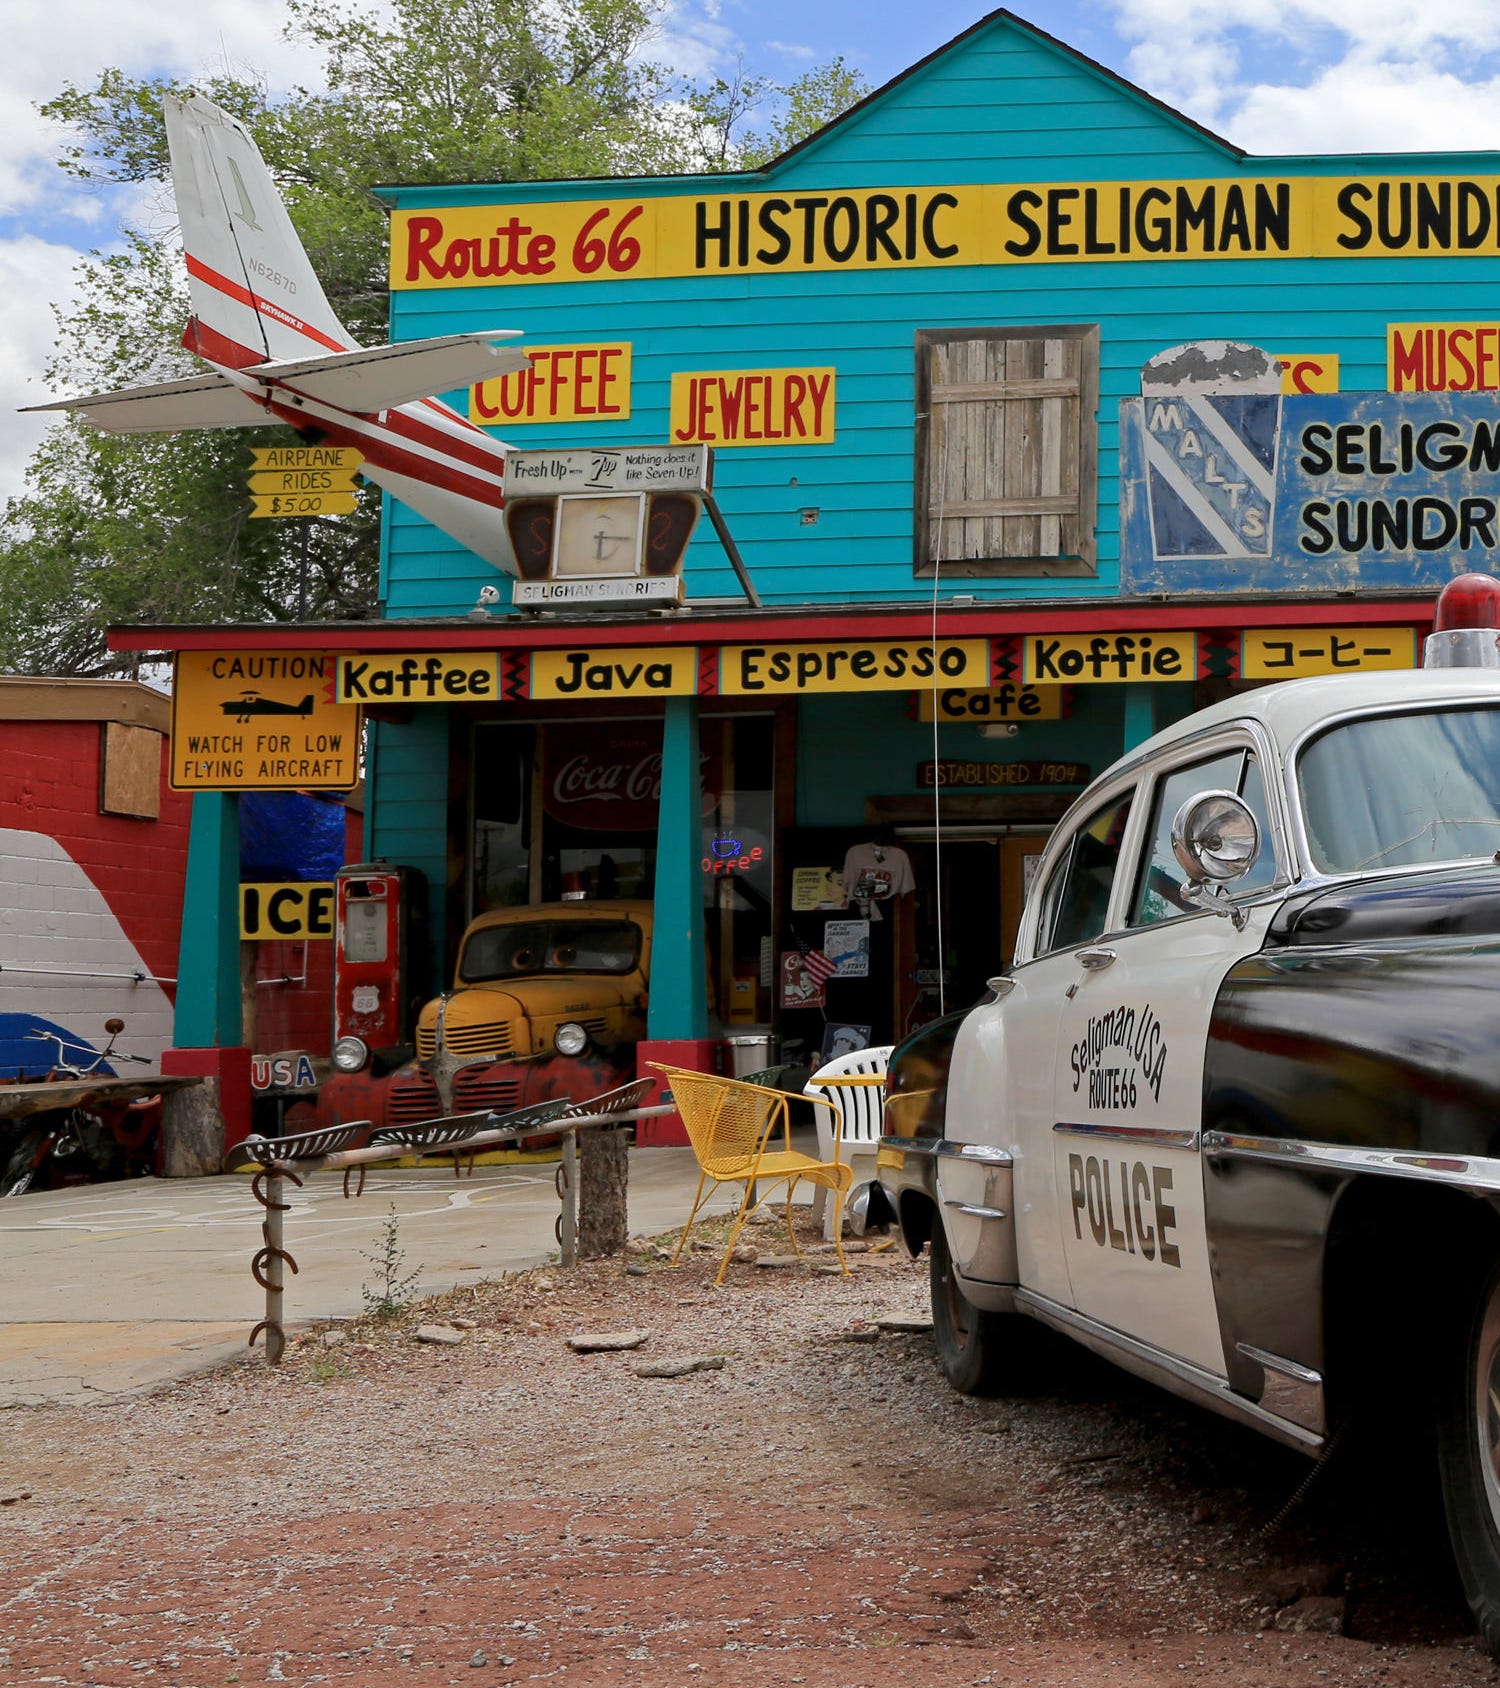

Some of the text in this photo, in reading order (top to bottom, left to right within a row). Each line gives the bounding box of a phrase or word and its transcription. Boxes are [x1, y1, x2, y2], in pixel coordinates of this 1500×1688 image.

[406, 216, 556, 282] Route
[572, 204, 644, 274] 66
[695, 192, 958, 269] HISTORIC
[1004, 183, 1290, 257] SELIGMAN
[249, 257, 297, 295] N6267D
[260, 301, 297, 327] SKYHAWK
[675, 372, 831, 442] JEWELRY
[266, 449, 345, 467] AIRPLANE
[626, 454, 697, 466] Nothing does it
[626, 469, 642, 480] like
[1150, 403, 1264, 538] MALTS
[282, 471, 332, 490] RIDES
[270, 497, 322, 514] $5.00
[212, 657, 325, 679] CAUTION
[740, 646, 968, 690] Espresso
[1035, 636, 1183, 678] Koffie
[1263, 635, 1392, 668] コーヒー
[343, 658, 490, 699] Kaffee
[555, 652, 673, 693] Java
[941, 684, 1042, 717] Café
[188, 735, 342, 754] WATCH FOR LOW
[184, 760, 343, 778] FLYING AIRCRAFT
[925, 763, 1078, 785] ESTABLISHED 1904
[243, 887, 334, 934] ICE
[1134, 1003, 1168, 1104] USA
[251, 1055, 317, 1090] USA
[1089, 1067, 1137, 1109] ROUTE 66
[1069, 1152, 1182, 1269] POLICE
